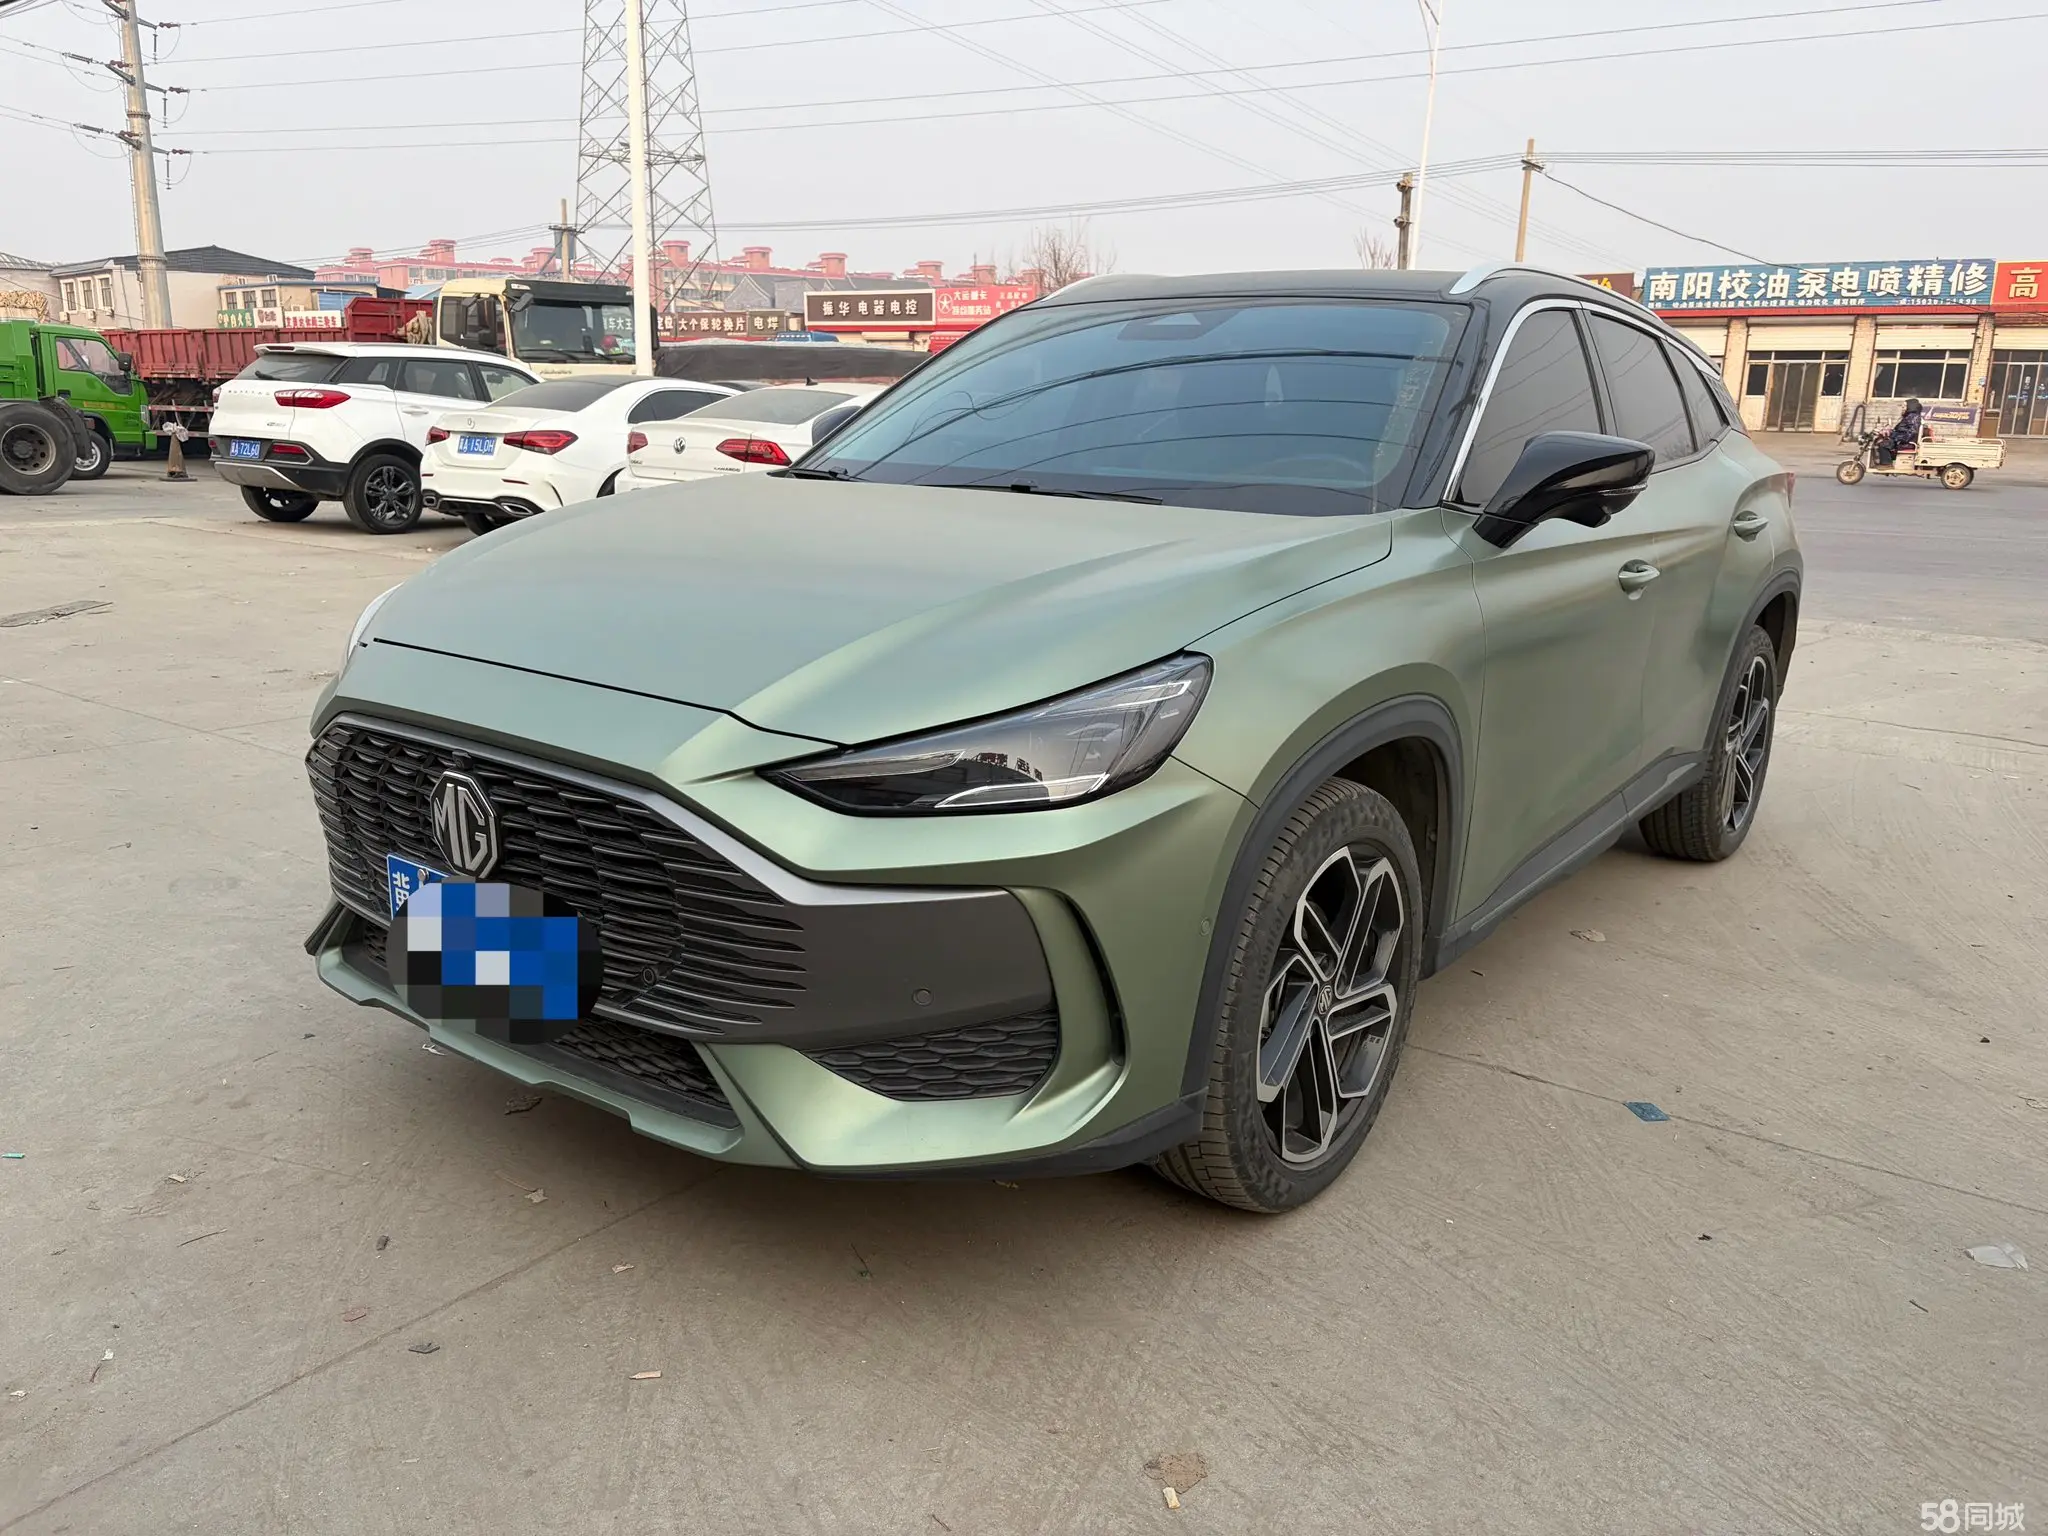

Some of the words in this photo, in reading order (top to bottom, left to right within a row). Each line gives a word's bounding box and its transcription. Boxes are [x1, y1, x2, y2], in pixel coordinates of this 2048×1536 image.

[1649, 262, 1988, 300] 南阳校油泵电喷精修
[2009, 267, 2043, 299] 高
[433, 782, 488, 873] MG
